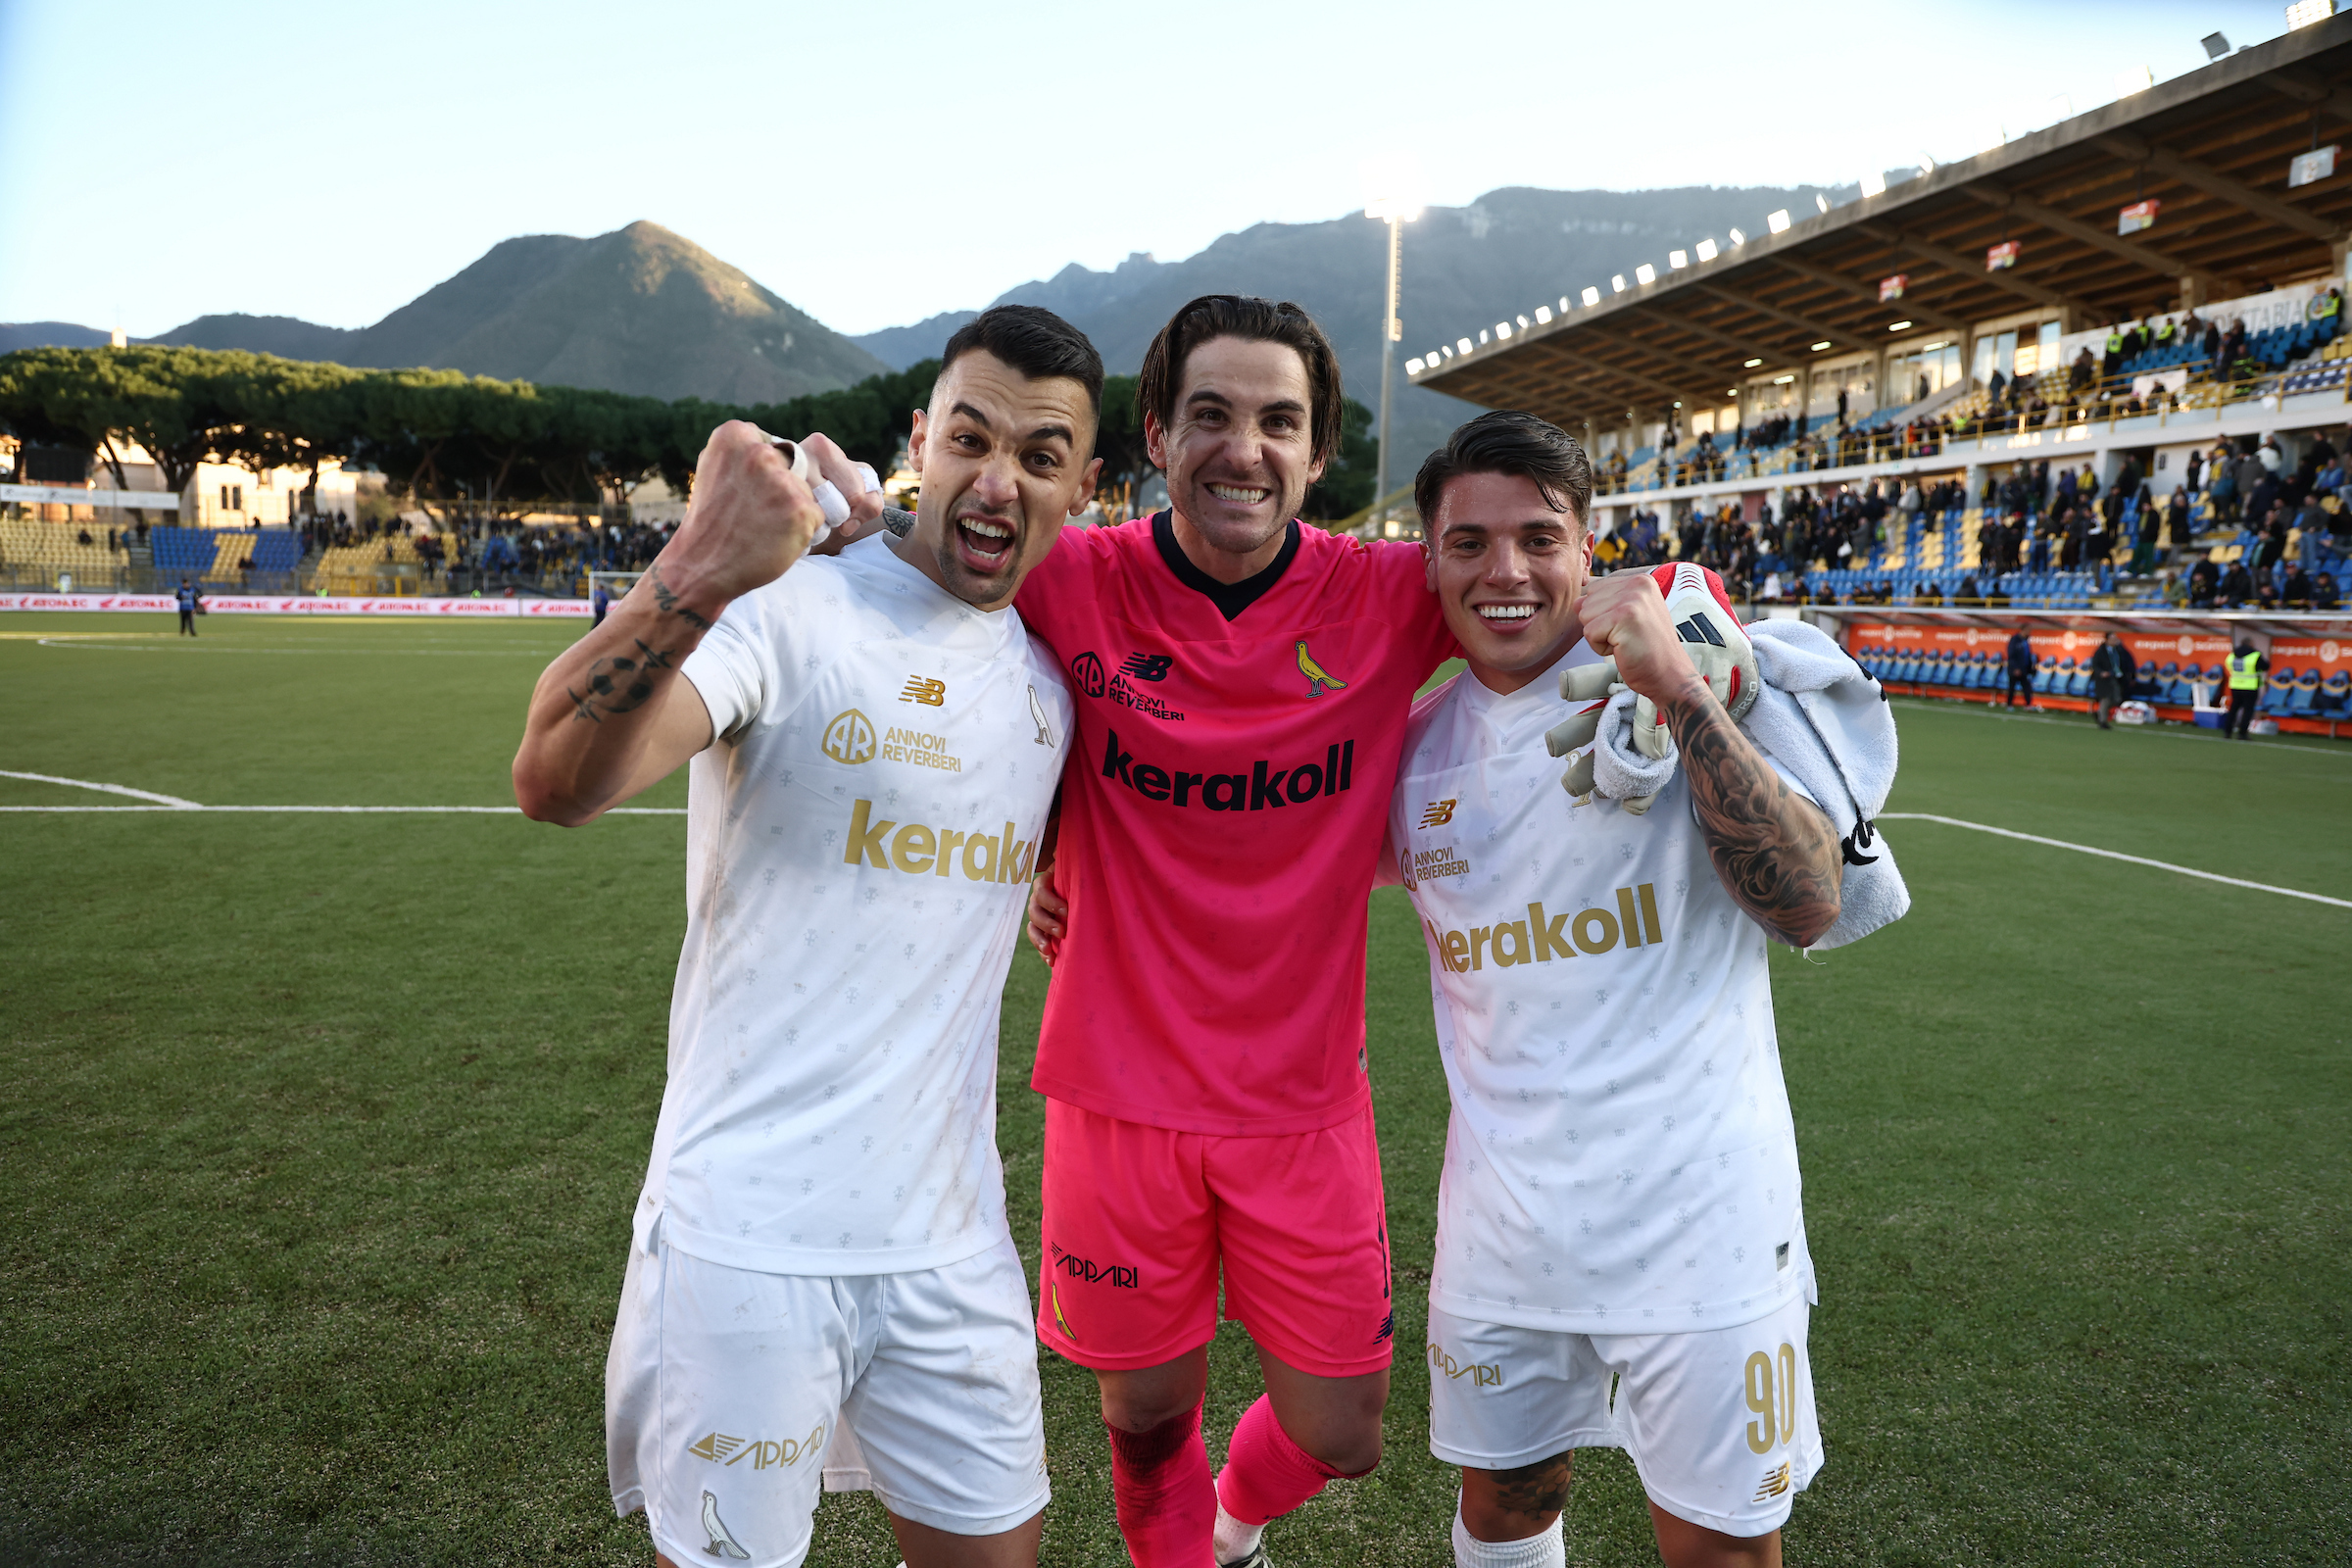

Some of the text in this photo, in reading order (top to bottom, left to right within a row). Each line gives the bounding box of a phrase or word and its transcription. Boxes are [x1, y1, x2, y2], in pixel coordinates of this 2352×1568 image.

[1109, 673, 1165, 710] ANNOVI
[1108, 687, 1185, 721] REVERBERI
[1731, 681, 1757, 717] PRED
[885, 727, 947, 754] ANNOVI
[882, 744, 961, 772] REVERBERI
[1102, 728, 1354, 811] kerakoll
[770, 825, 784, 836] 1912
[1414, 846, 1453, 867] ANNOVI
[1573, 857, 1585, 866] 1912
[1415, 859, 1470, 882] REVERBERI
[813, 884, 827, 895] 1912
[1427, 882, 1663, 973] kerakoll
[1642, 987, 1654, 996] 1912
[1600, 1039, 1612, 1049] 1912
[1654, 1074, 1666, 1084] 1912
[1614, 1128, 1626, 1138] 1912
[1670, 1167, 1683, 1177] 1912
[749, 1176, 762, 1186] 1912
[1726, 1204, 1739, 1214] 1912
[1629, 1219, 1642, 1228] 1912
[789, 1233, 802, 1244] 1912
[1684, 1258, 1696, 1268] 1912
[1642, 1308, 1654, 1317] 1912
[1744, 1343, 1794, 1454] 90
